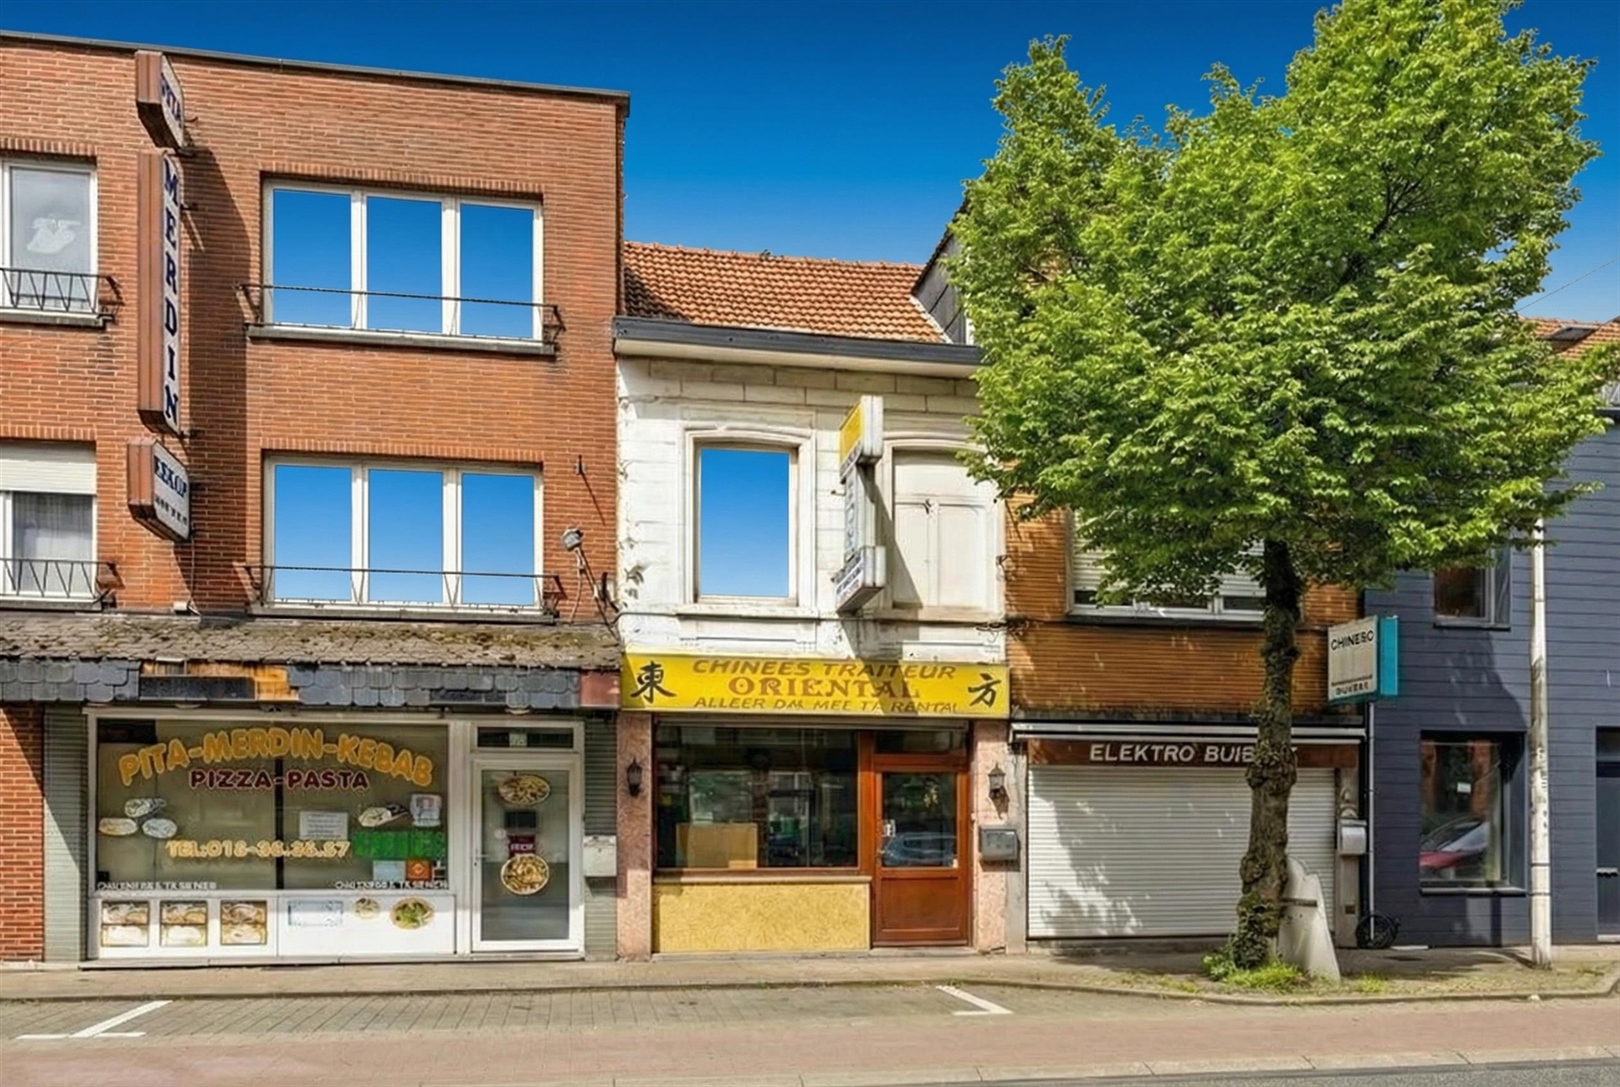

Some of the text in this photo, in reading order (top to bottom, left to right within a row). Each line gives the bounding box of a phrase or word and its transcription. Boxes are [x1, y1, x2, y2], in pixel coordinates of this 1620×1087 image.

[164, 156, 179, 427] MERDIN
[629, 660, 678, 705] 東
[693, 659, 957, 680] CHINEES TRAITEUR
[728, 676, 921, 699] ORIENTAL
[967, 672, 1002, 709] 方
[118, 727, 433, 787] PITA-MERDIN-KEBAB
[1090, 743, 1196, 763] ELEKTRO
[188, 768, 369, 790] PIZZA-PASTA
